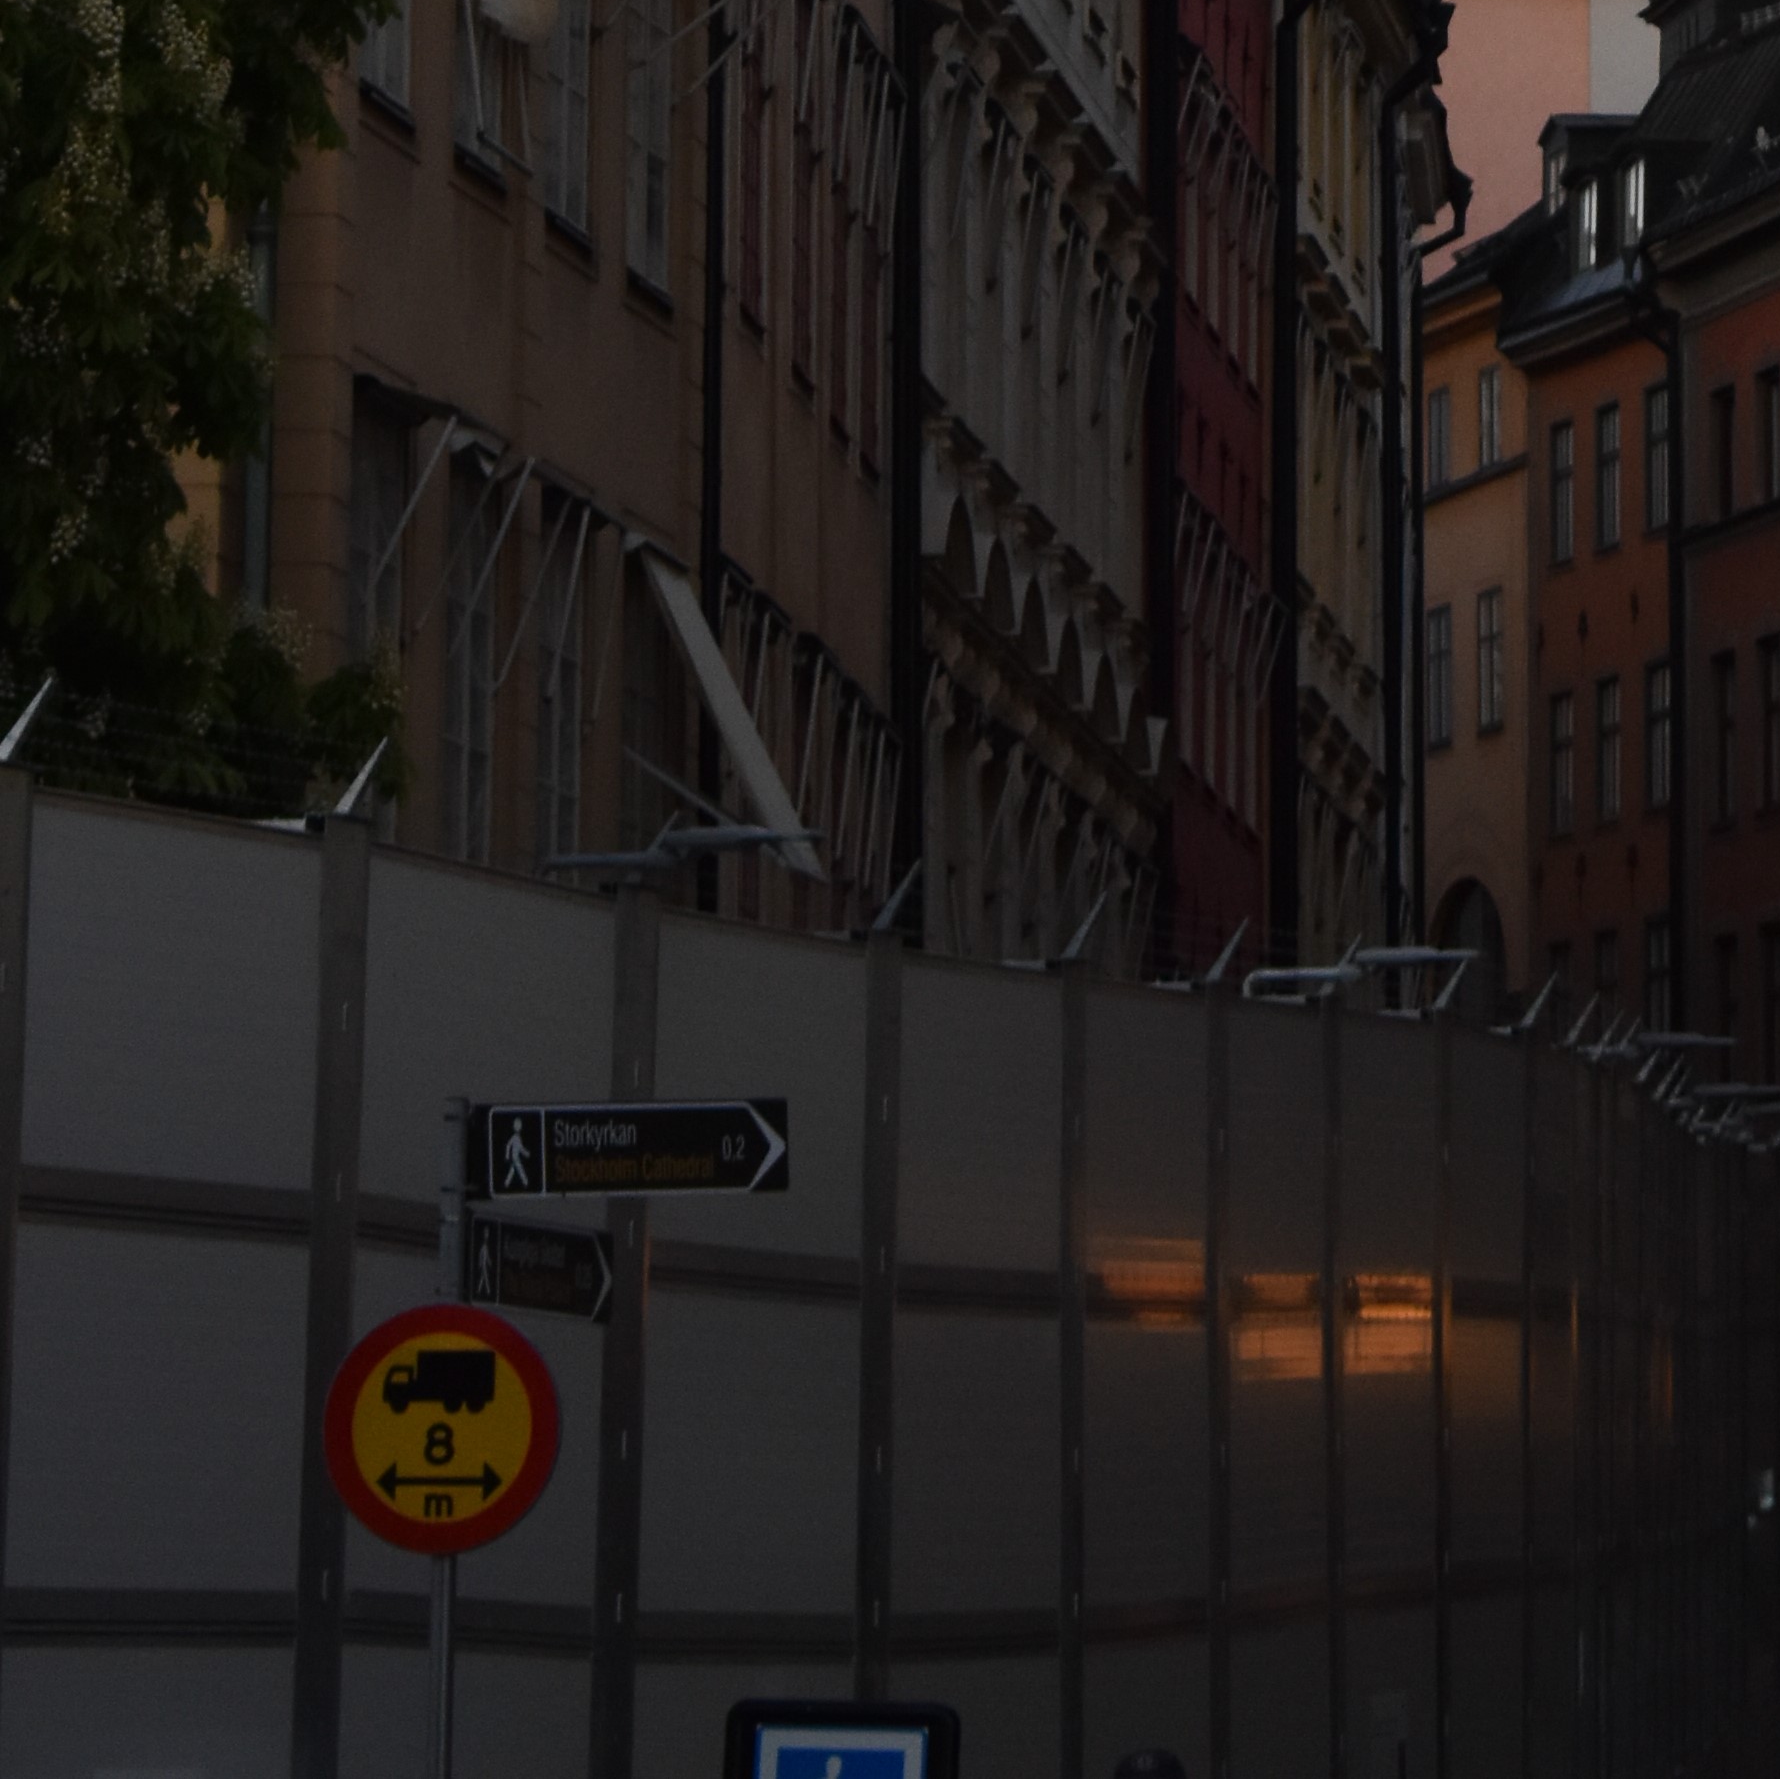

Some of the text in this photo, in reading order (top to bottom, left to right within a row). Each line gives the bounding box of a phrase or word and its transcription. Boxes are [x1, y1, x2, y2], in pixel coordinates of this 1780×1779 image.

[554, 1119, 637, 1152] Storkyrkan
[554, 1152, 714, 1184] Stockholm Cathedral
[425, 1423, 455, 1465] 8
[424, 1493, 453, 1518] m
